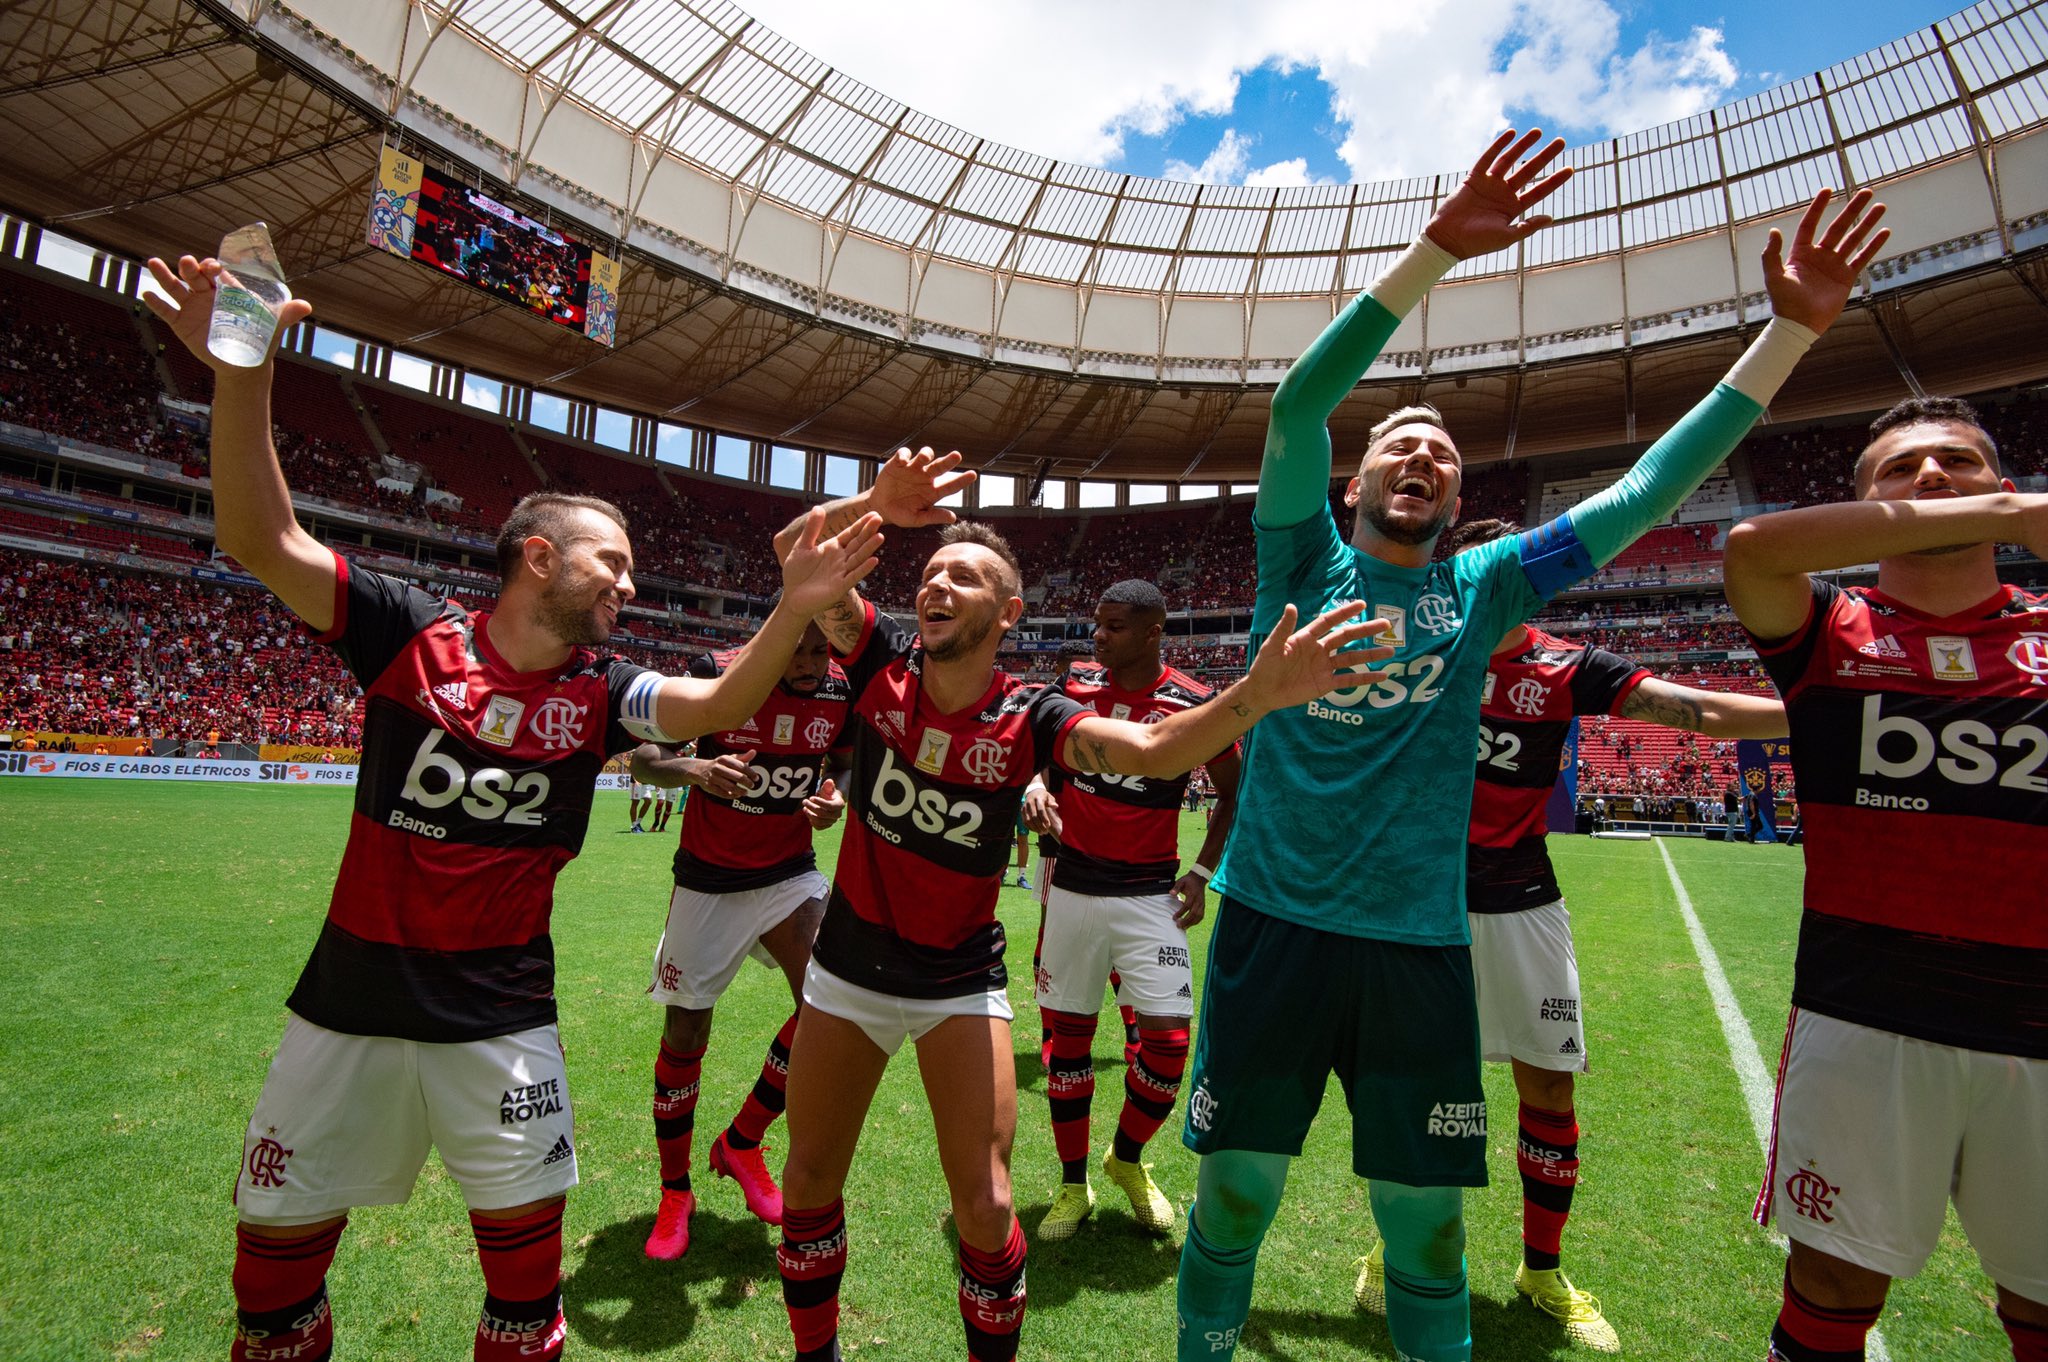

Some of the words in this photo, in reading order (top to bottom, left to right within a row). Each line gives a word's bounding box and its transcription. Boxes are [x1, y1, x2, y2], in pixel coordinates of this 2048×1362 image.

[1859, 645, 1907, 659] adidas
[433, 685, 467, 710] adidas
[1307, 701, 1364, 725] Banco
[64, 761, 101, 773] FIOS
[104, 762, 116, 773] E
[120, 763, 171, 775] CABOS
[174, 763, 251, 777] ELÉTRICOS
[258, 763, 288, 781] Sil
[315, 770, 343, 780] FIOS
[345, 771, 354, 780] E
[400, 728, 551, 826] bs2
[1073, 776, 1096, 794] Banco
[732, 799, 765, 815] Banco
[871, 747, 983, 849] bs2
[1855, 787, 1930, 811] Banco
[388, 809, 447, 839] Banco
[866, 811, 902, 844] Banco
[1158, 946, 1188, 958] AZEITE
[1158, 955, 1190, 969] ROYAL
[1541, 997, 1577, 1010] AZEITE
[1540, 1008, 1578, 1022] ROYAL
[500, 1077, 559, 1106] AZEITE
[500, 1098, 563, 1125] ROYAL
[1429, 1101, 1486, 1120] AZEITE
[1427, 1117, 1487, 1138] ROYAL
[543, 1149, 573, 1166] adidas
